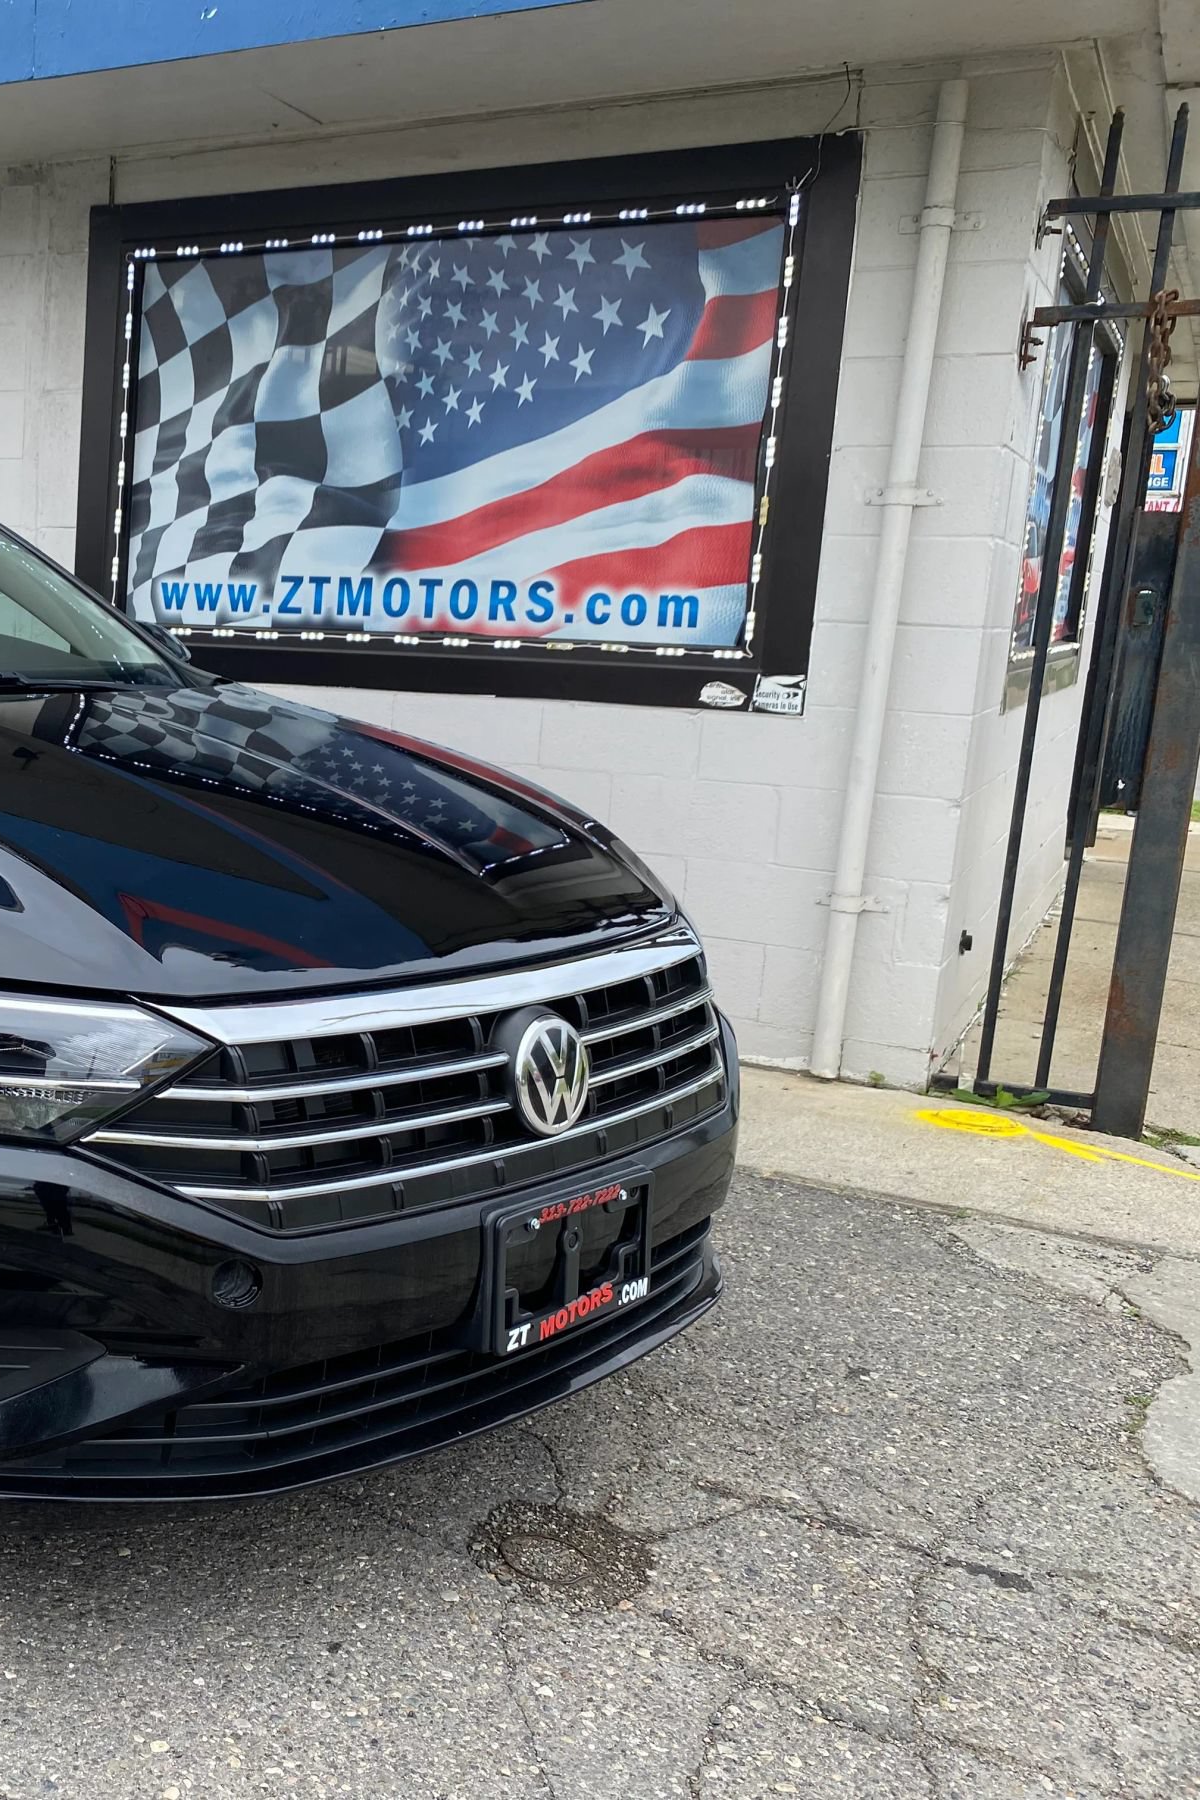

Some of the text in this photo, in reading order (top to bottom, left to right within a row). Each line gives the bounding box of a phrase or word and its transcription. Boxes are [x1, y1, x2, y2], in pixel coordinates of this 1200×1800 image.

[161, 575, 700, 628] www.ZTMOTORS.com
[755, 690, 780, 701] Security
[788, 702, 798, 710] Use
[507, 1276, 649, 1352] ZT MOTORS .COM
